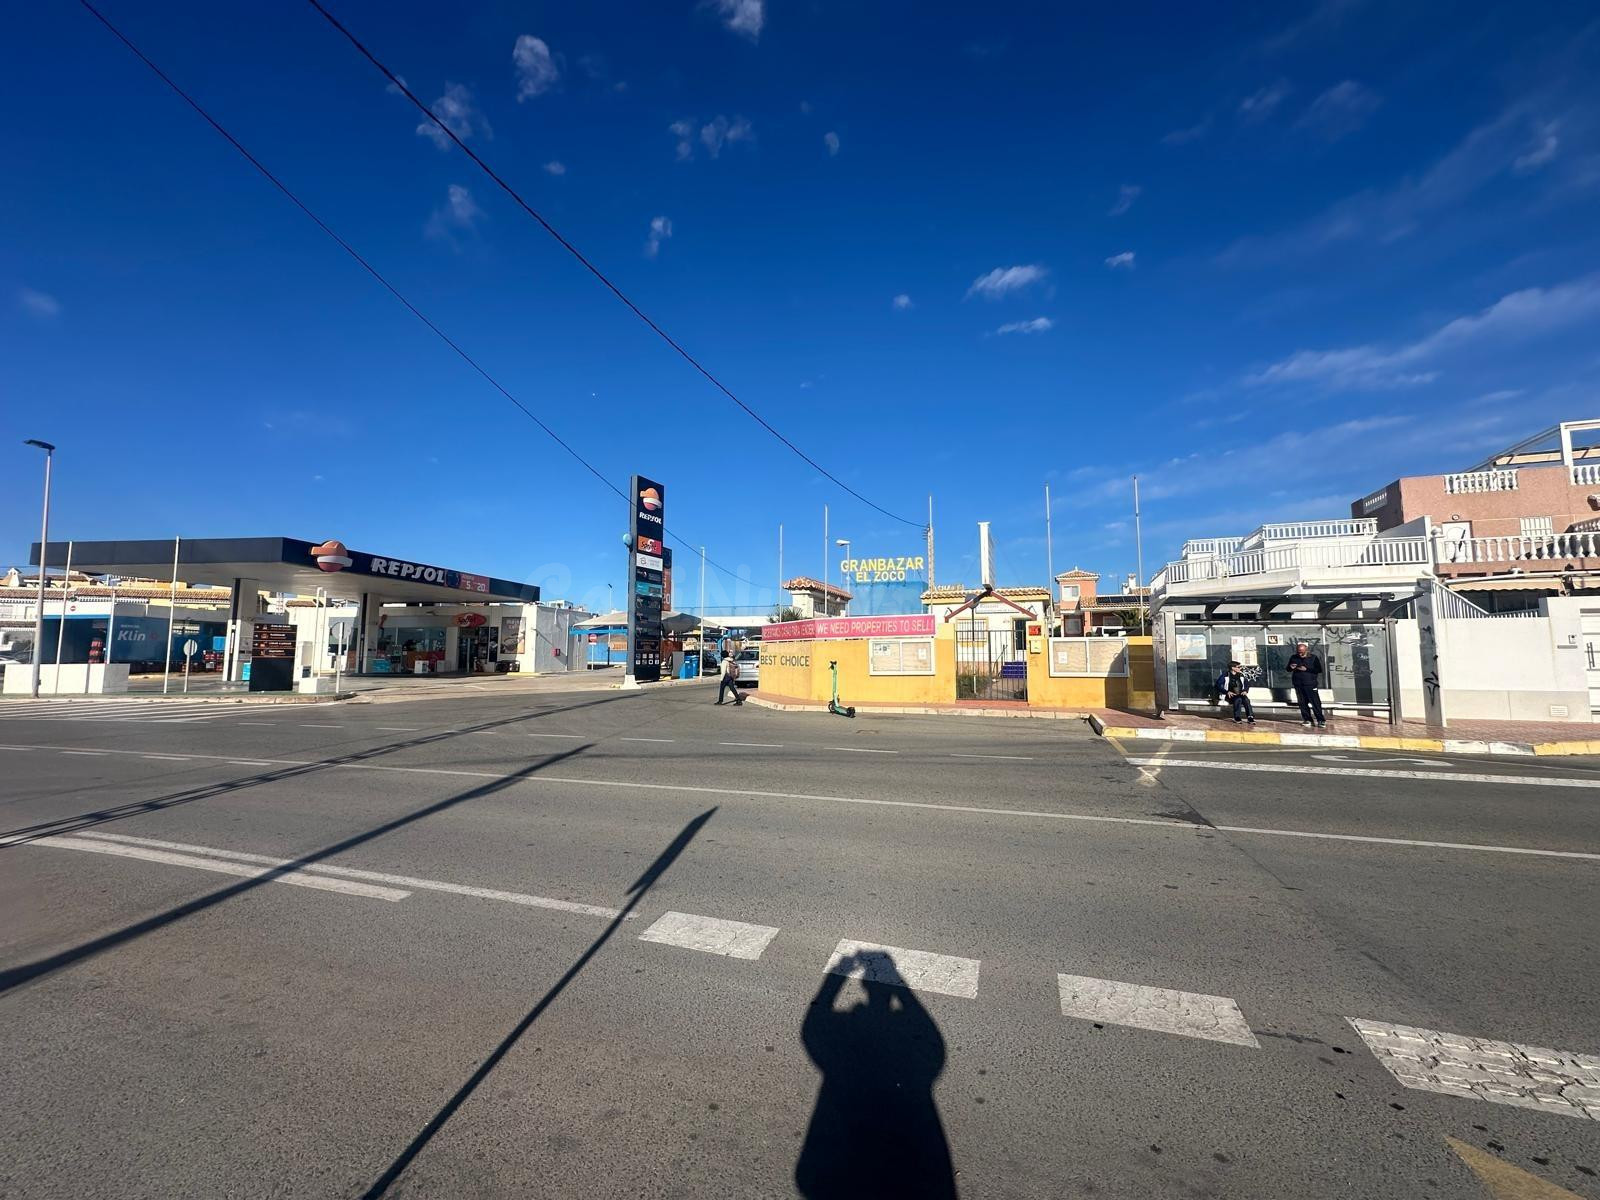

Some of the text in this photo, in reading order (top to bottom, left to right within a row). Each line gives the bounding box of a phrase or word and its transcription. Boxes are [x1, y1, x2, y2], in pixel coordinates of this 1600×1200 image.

[639, 512, 662, 524] REPSOL
[371, 558, 445, 583] REPSOL
[840, 556, 924, 573] GRANBAZAR
[855, 570, 905, 583] EL ZOCO
[817, 623, 828, 634] WE
[830, 622, 849, 634] NEED
[851, 620, 898, 633] PROPERTIES
[900, 620, 910, 632] TO
[117, 630, 146, 641] Klin
[760, 655, 810, 667] BEST CHOICE
